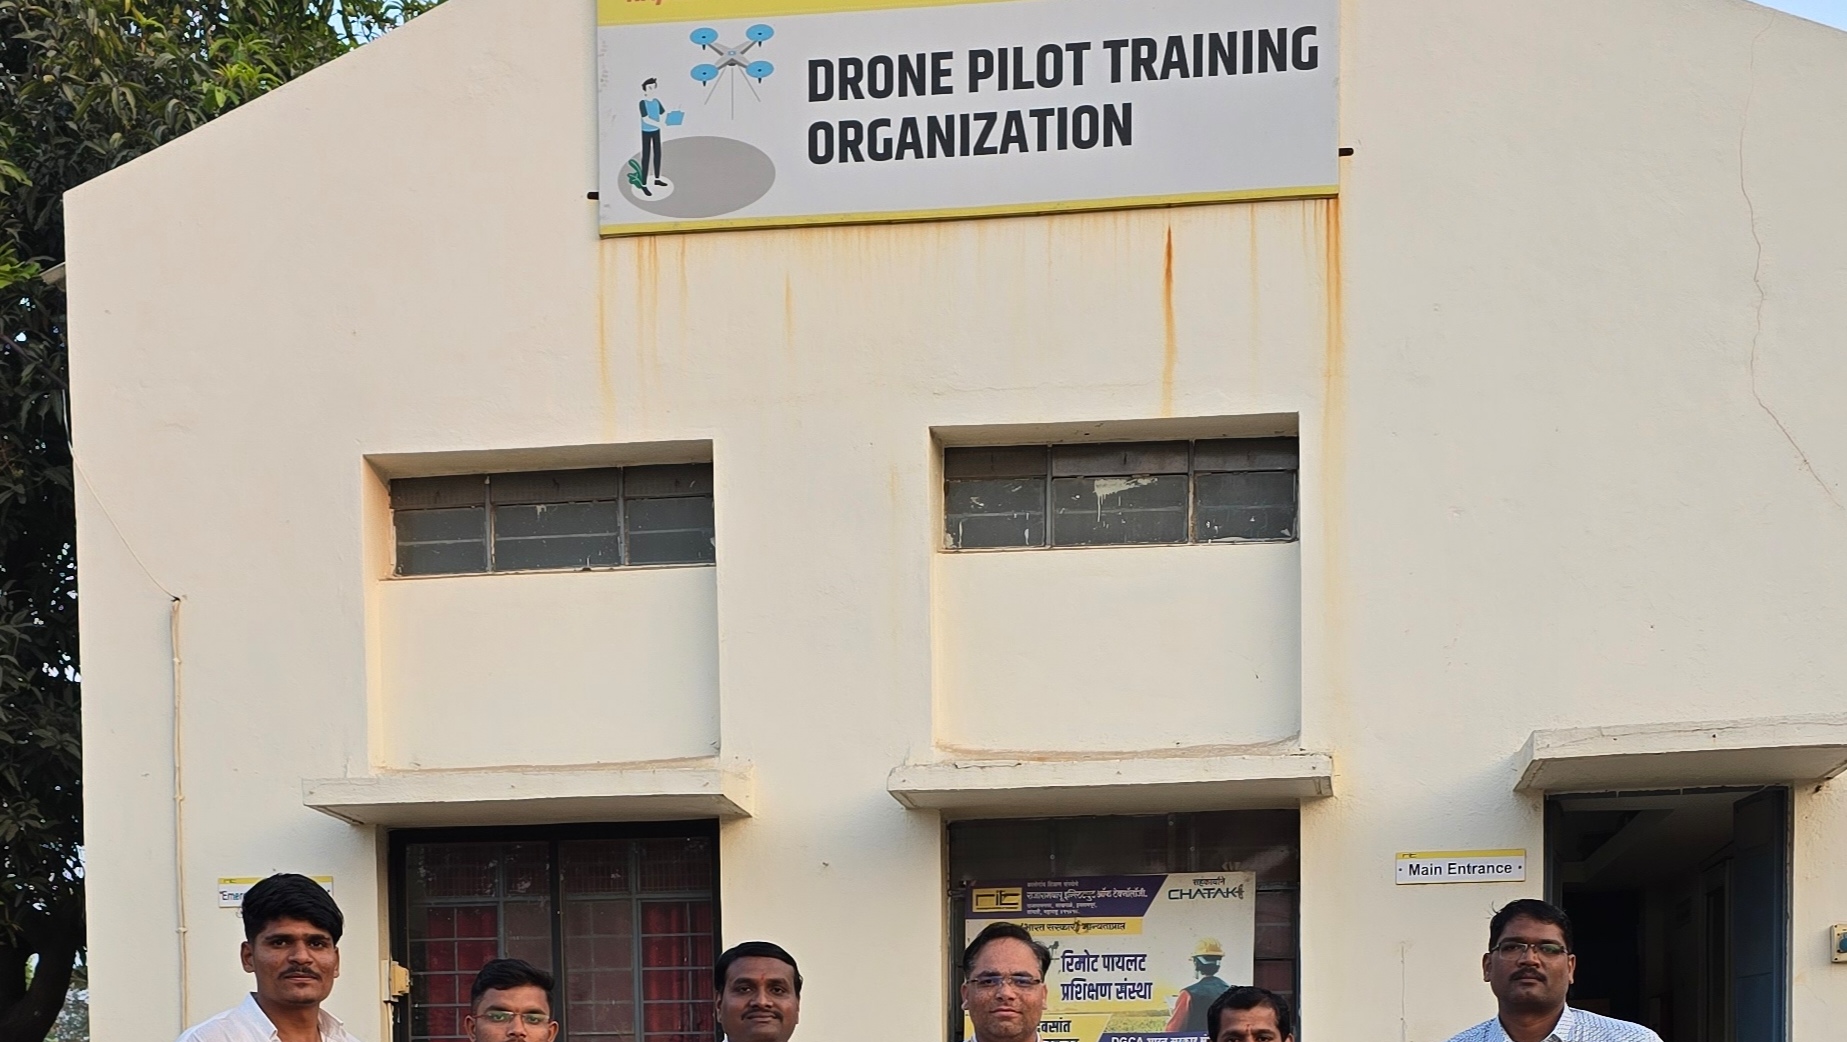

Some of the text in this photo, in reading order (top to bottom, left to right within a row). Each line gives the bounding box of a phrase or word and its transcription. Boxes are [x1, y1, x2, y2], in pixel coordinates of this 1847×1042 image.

[808, 25, 1319, 102] DRONE PILOT TRAINING
[808, 102, 1133, 165] ORGANIZATION
[1409, 863, 1512, 876] Main Entrance
[1168, 887, 1237, 900] CHATAK
[1060, 950, 1148, 973] रिमोट पायलट
[1060, 978, 1153, 1001] प्रशिक्षण संस्था
